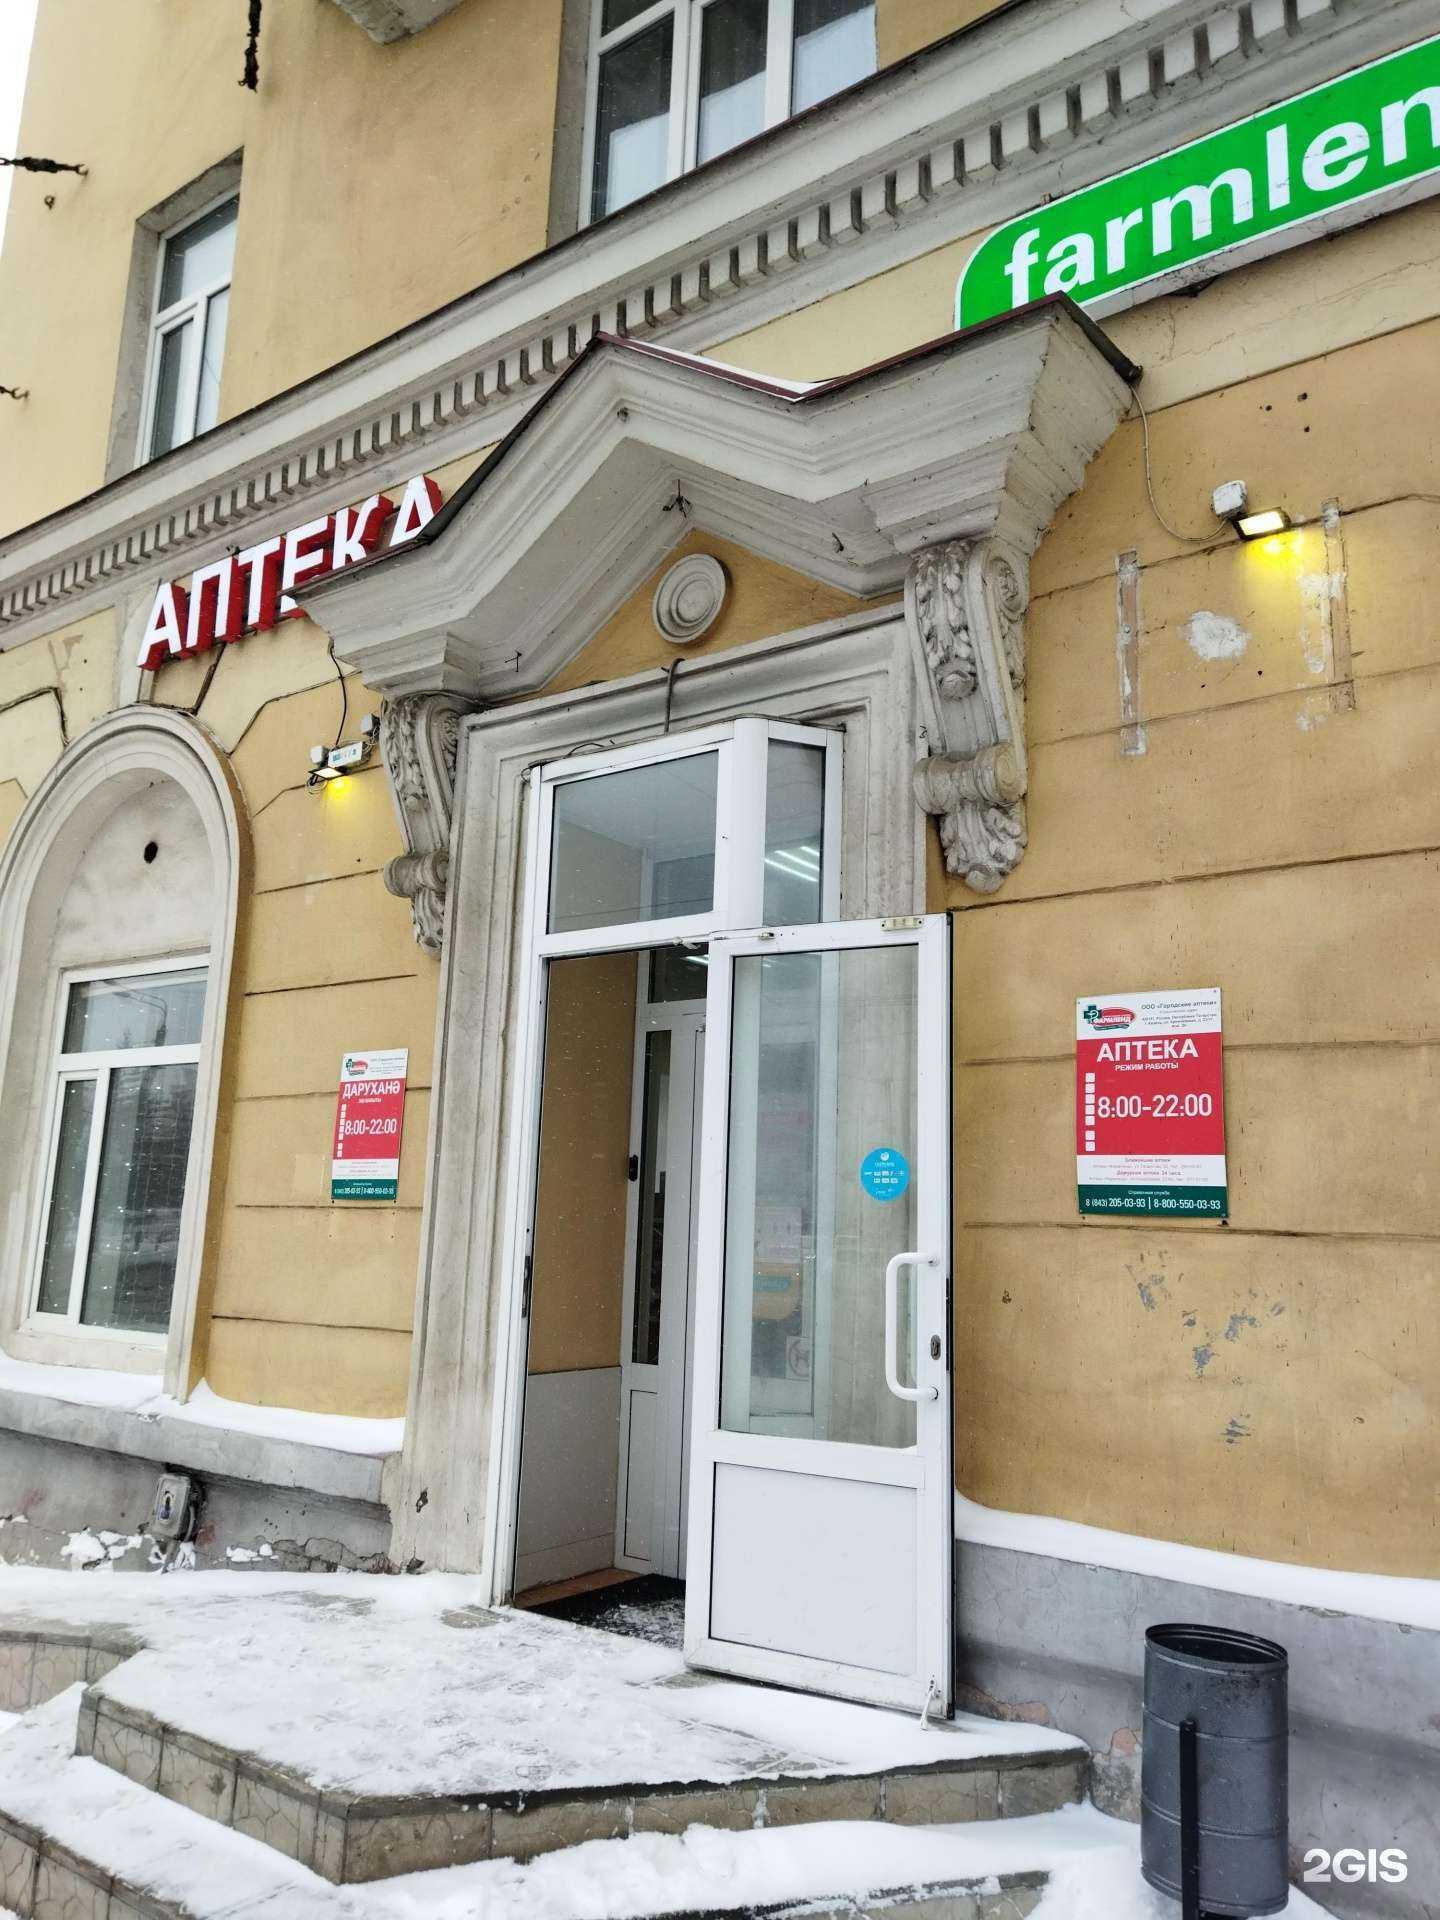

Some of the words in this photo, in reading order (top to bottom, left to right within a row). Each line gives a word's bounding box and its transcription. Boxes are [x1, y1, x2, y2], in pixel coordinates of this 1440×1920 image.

[137, 473, 444, 669] АПТЕКА
[1096, 1038, 1199, 1063] АПТЕКА
[1115, 1064, 1144, 1072] РЕЖИМ
[1145, 1062, 1179, 1071] РАБОТЫ
[342, 1080, 401, 1100] ДАРУХАНӘ
[1097, 1093, 1213, 1119] 8:00-22:00
[344, 1118, 397, 1136] 8:00-22:00
[1085, 1199, 1090, 1207] 8
[1091, 1198, 1108, 1207] (843)
[1108, 1198, 1146, 1208] 205-03-93
[1153, 1199, 1221, 1210] 8-800-550-03-93
